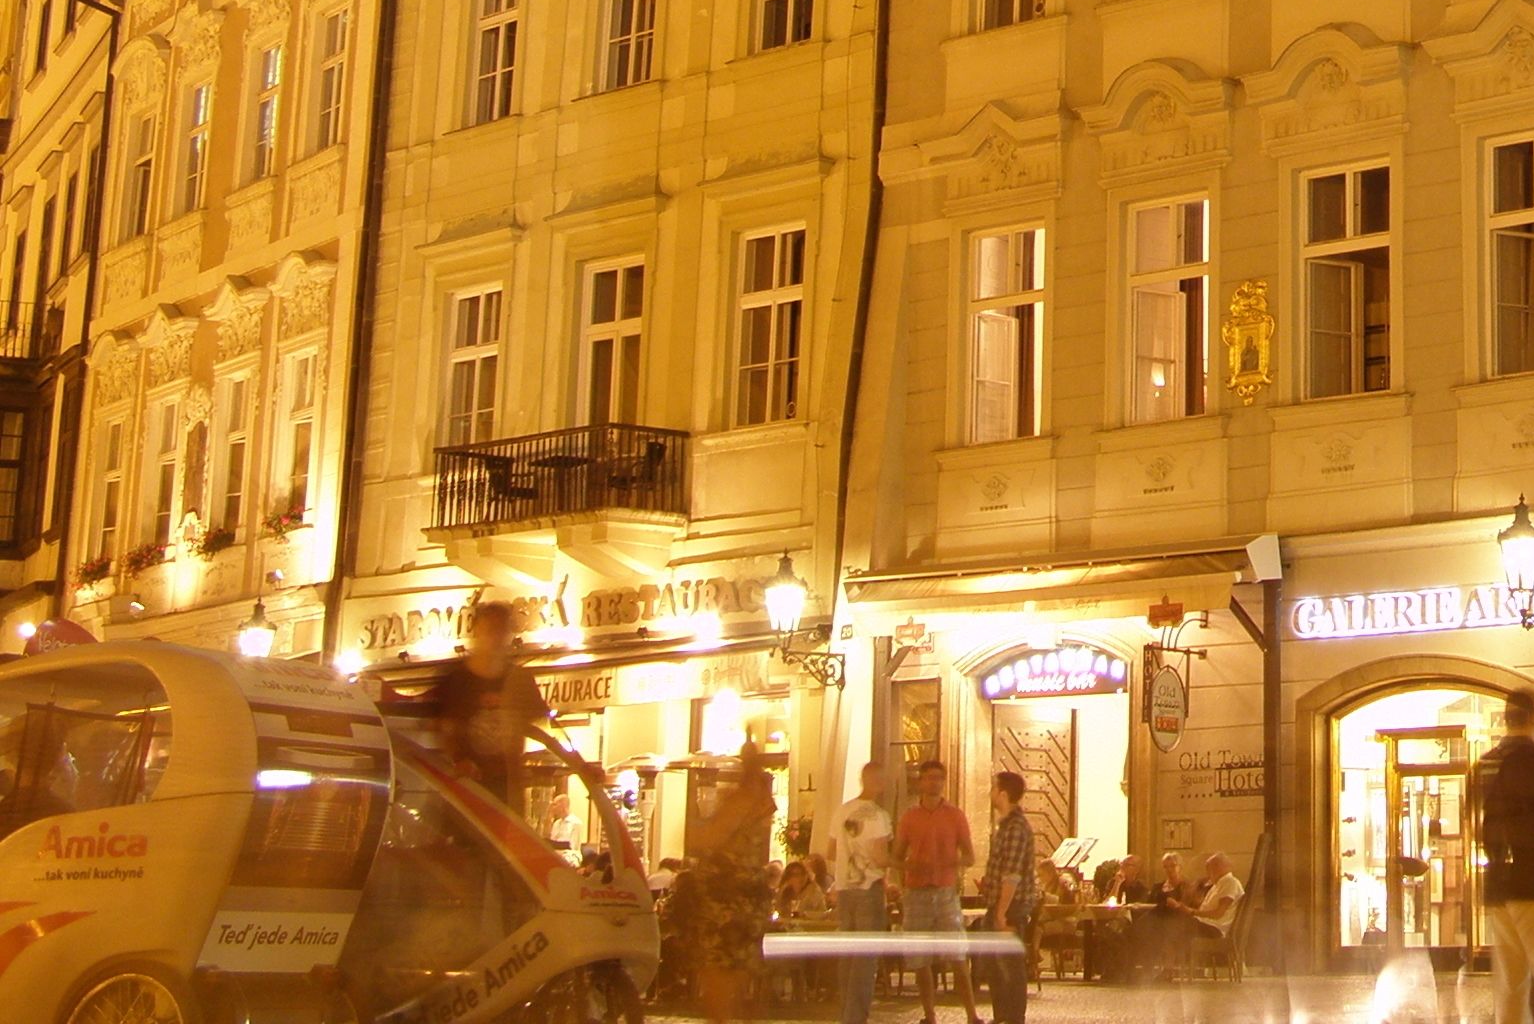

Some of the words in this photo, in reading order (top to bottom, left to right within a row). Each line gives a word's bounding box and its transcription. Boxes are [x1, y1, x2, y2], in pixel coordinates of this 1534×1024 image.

[1291, 590, 1455, 634] GALERIE
[1179, 751, 1211, 770] Old
[37, 822, 148, 859] Amica
[66, 867, 91, 880] voní
[93, 866, 144, 881] kuchyně
[247, 925, 288, 950] jede
[290, 926, 340, 945] Amica
[483, 931, 549, 997] Amica
